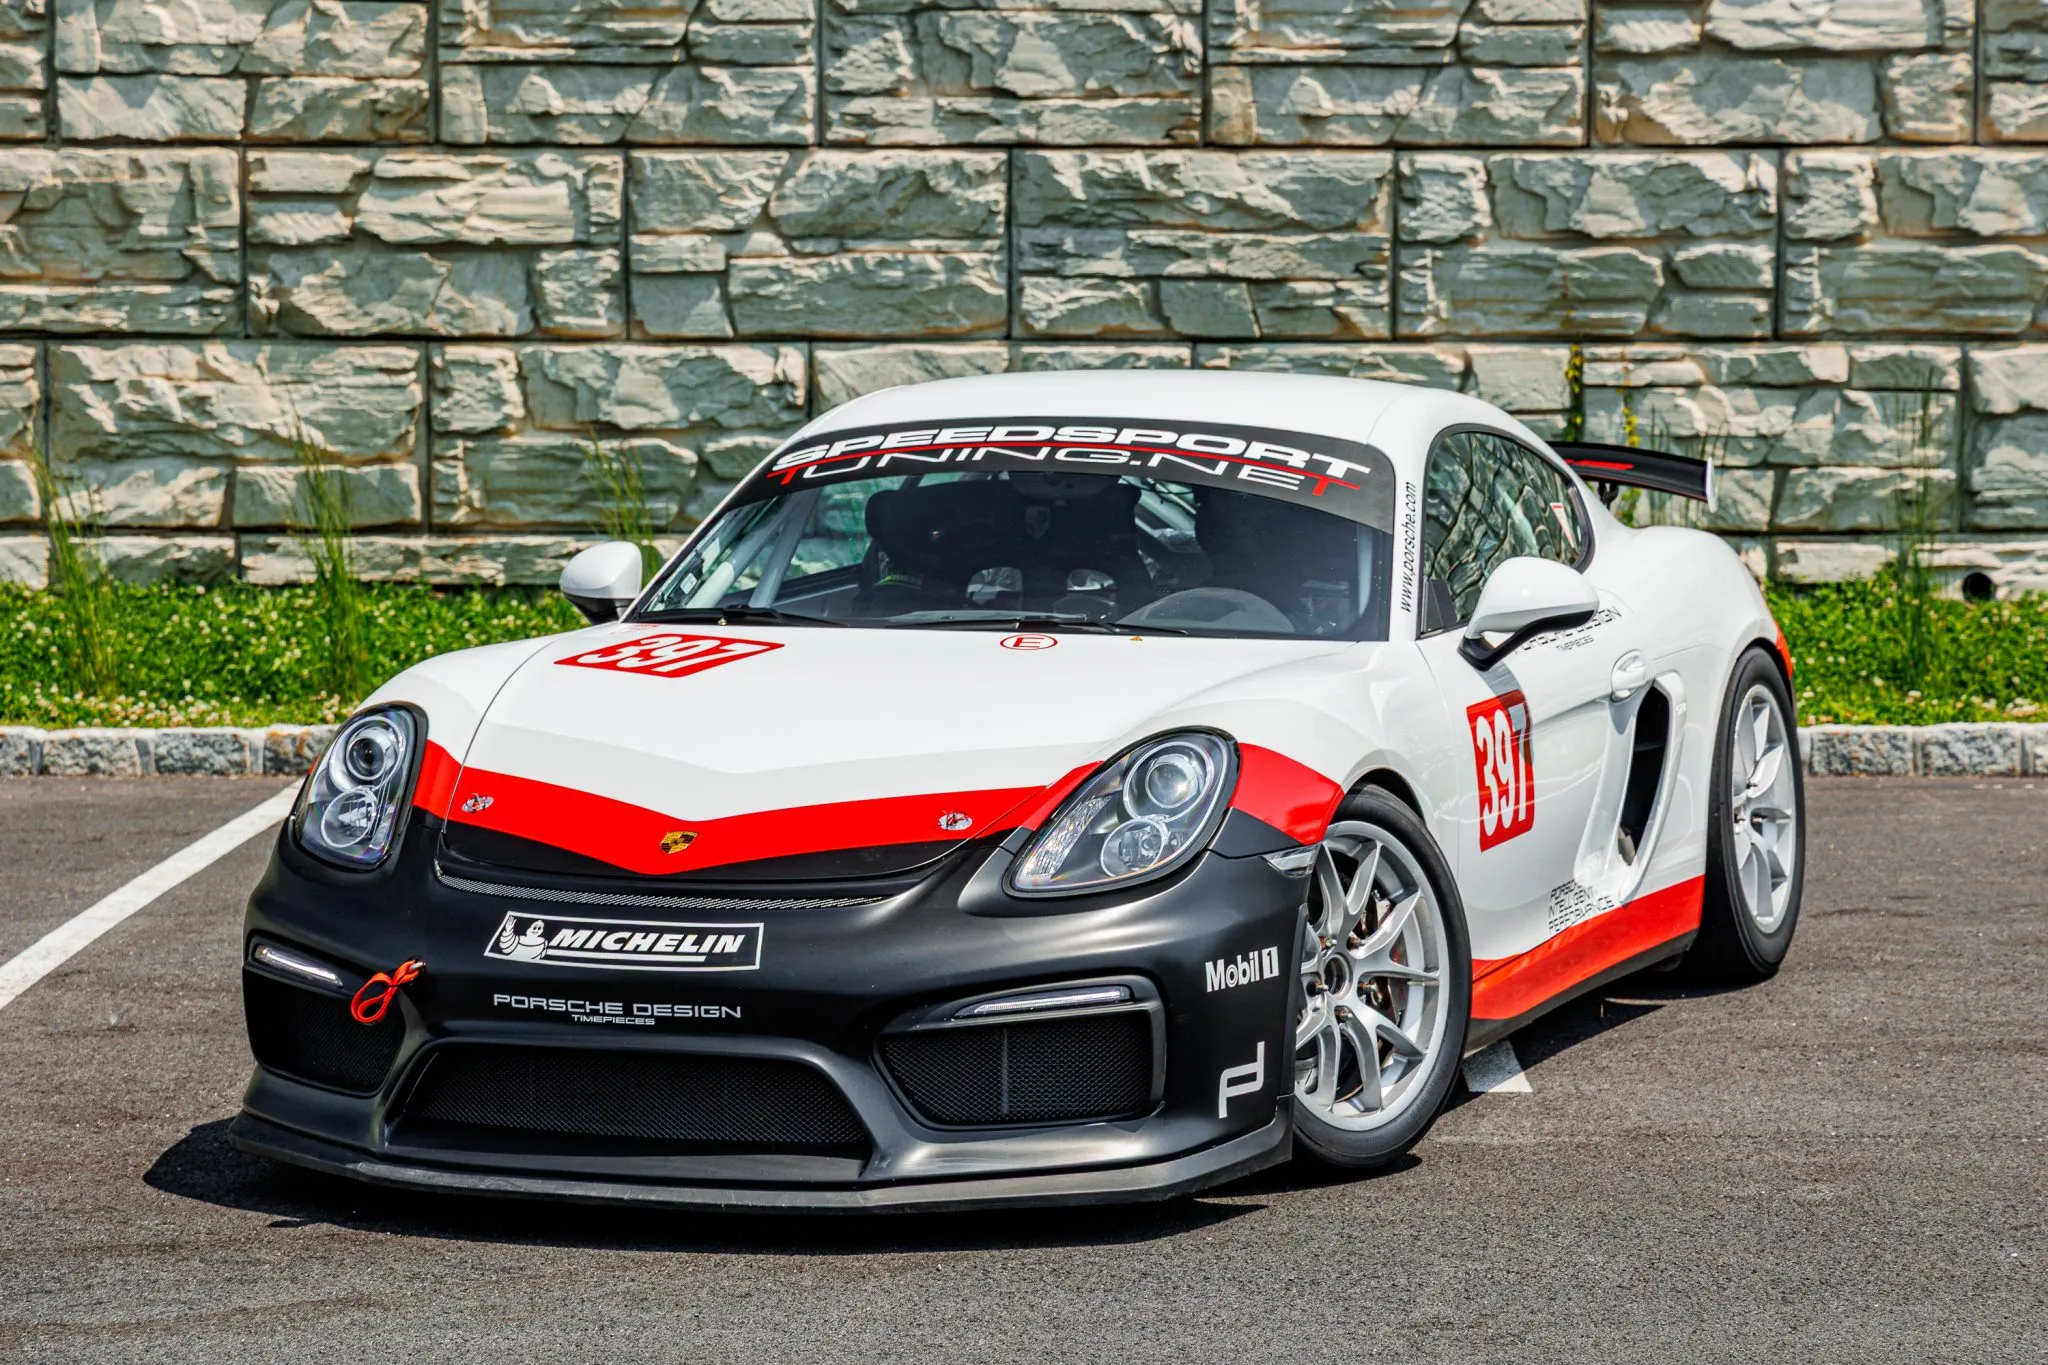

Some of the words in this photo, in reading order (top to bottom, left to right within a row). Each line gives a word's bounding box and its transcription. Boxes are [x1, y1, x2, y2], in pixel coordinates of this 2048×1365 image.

[767, 443, 1361, 496] TUNING.NET
[772, 426, 1371, 479] SPEEDSPORT
[1401, 481, 1416, 613] www.porsche.com
[577, 636, 770, 673] 397
[1476, 702, 1527, 836] 397
[549, 928, 746, 954] MICHELIN
[1205, 951, 1260, 993] Mobil
[1263, 947, 1279, 978] 1
[493, 994, 623, 1015] PORSCHE
[633, 1003, 742, 1019] DESIGN
[571, 1014, 656, 1026] TIMEPIECES
